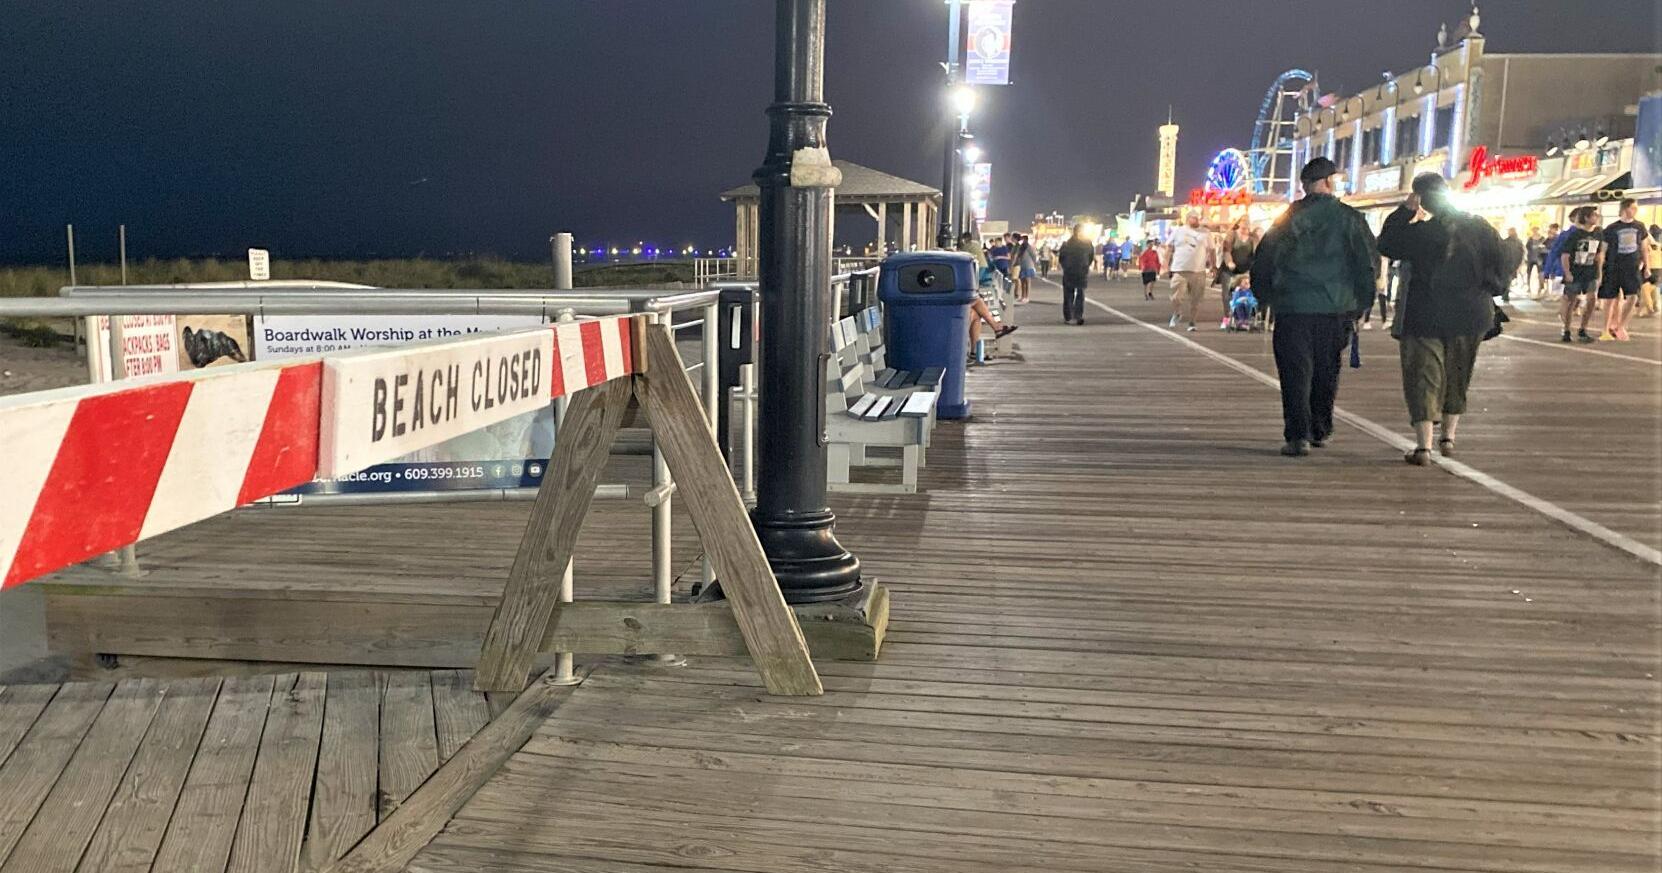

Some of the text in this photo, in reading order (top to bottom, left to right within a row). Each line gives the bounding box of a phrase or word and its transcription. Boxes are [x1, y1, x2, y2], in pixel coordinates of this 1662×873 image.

[264, 328, 347, 342] Boardwalk
[350, 327, 414, 342] Worship
[418, 329, 433, 340] at
[267, 345, 303, 355] Sundays
[305, 345, 314, 353] at
[126, 357, 141, 376] FTER
[372, 348, 542, 443] BEACH CLOSED
[404, 467, 484, 480] 609.399.1915
